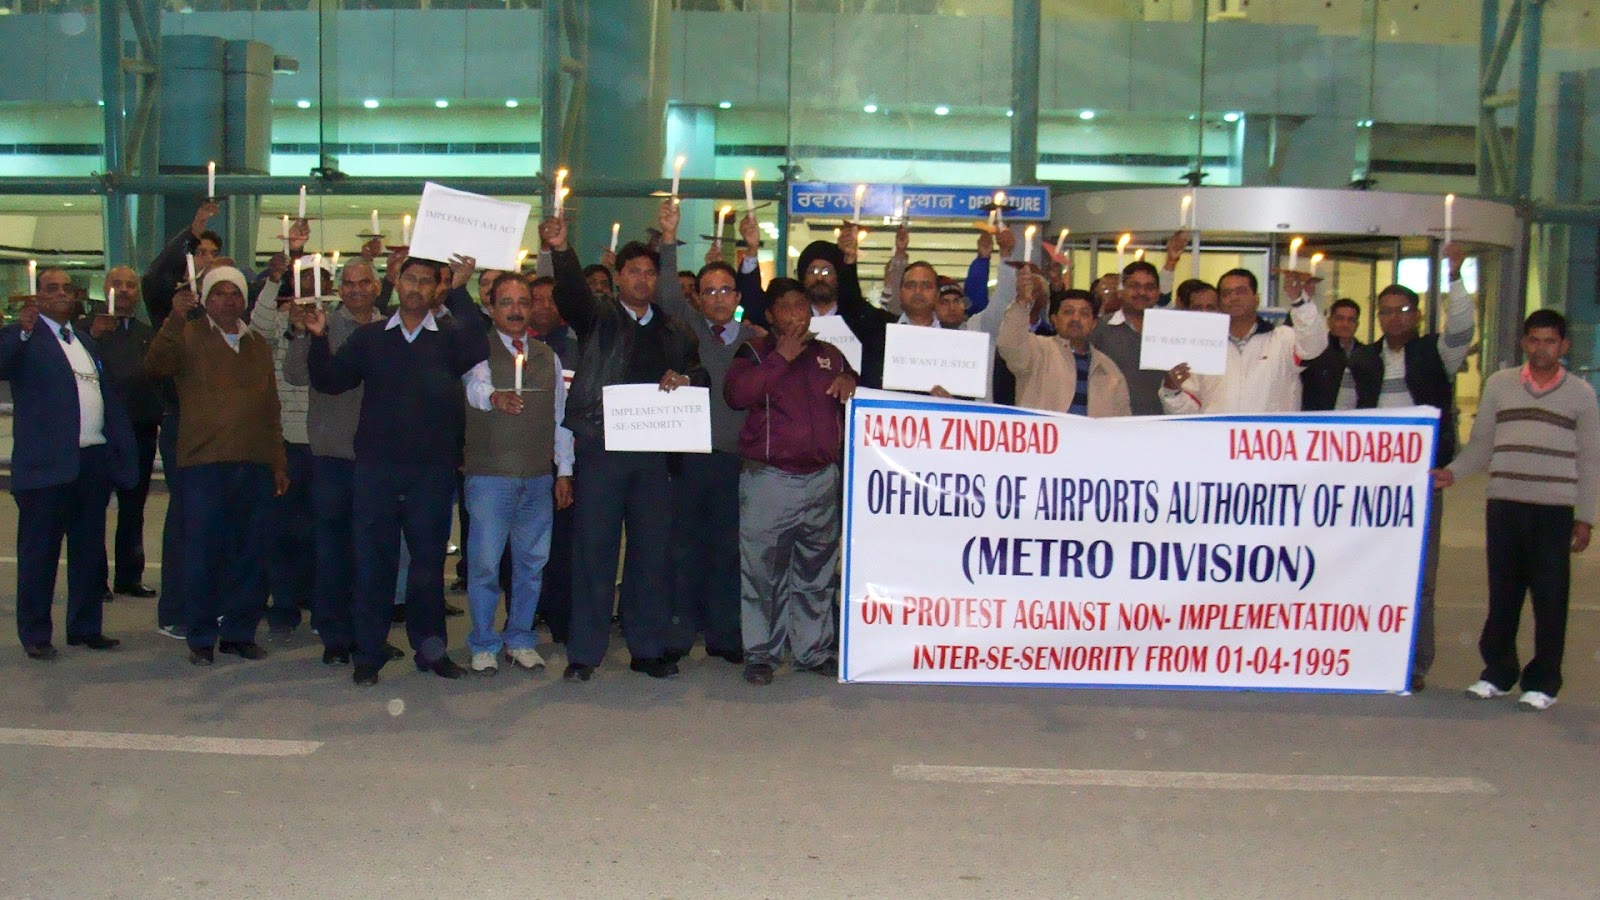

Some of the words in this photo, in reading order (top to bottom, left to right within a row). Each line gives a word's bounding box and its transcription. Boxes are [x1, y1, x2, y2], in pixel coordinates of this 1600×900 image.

[968, 195, 1041, 211] DEPTURE
[425, 210, 479, 227] IMPLEMENT
[481, 221, 498, 232] AAI
[500, 226, 517, 235] ACT
[892, 356, 908, 365] WE
[909, 357, 938, 367] WANT
[939, 359, 978, 369] JUSTICE
[611, 406, 671, 417] IMPLEMENT
[673, 404, 703, 414] INTER
[612, 420, 684, 431] -SE-SENIORITY
[864, 414, 932, 450] IAAOA
[940, 417, 1059, 455] ZINDABAD
[1229, 428, 1298, 461] IAAOA
[1306, 430, 1423, 464] ZINDABAD
[867, 469, 986, 519] OFFICERS
[995, 474, 1028, 520] OF
[1035, 477, 1160, 524] AIRPORTS
[1167, 481, 1307, 527] AUTHORITY
[1313, 483, 1346, 528] OF
[1351, 485, 1414, 528] INDIA
[962, 536, 1114, 584] (METRO
[1130, 541, 1315, 591] DIVISION)
[861, 594, 893, 625] ON
[902, 595, 1007, 628] PROTEST
[1013, 599, 1110, 631] AGAINST
[1117, 601, 1171, 632] NON-
[1178, 602, 1371, 633] IMPLEMENTATION
[1377, 604, 1408, 633] OF
[912, 644, 1140, 672] INTER-SE-SENIORITY
[1144, 644, 1208, 673] FROM
[1216, 645, 1351, 676] 01-04-1995
